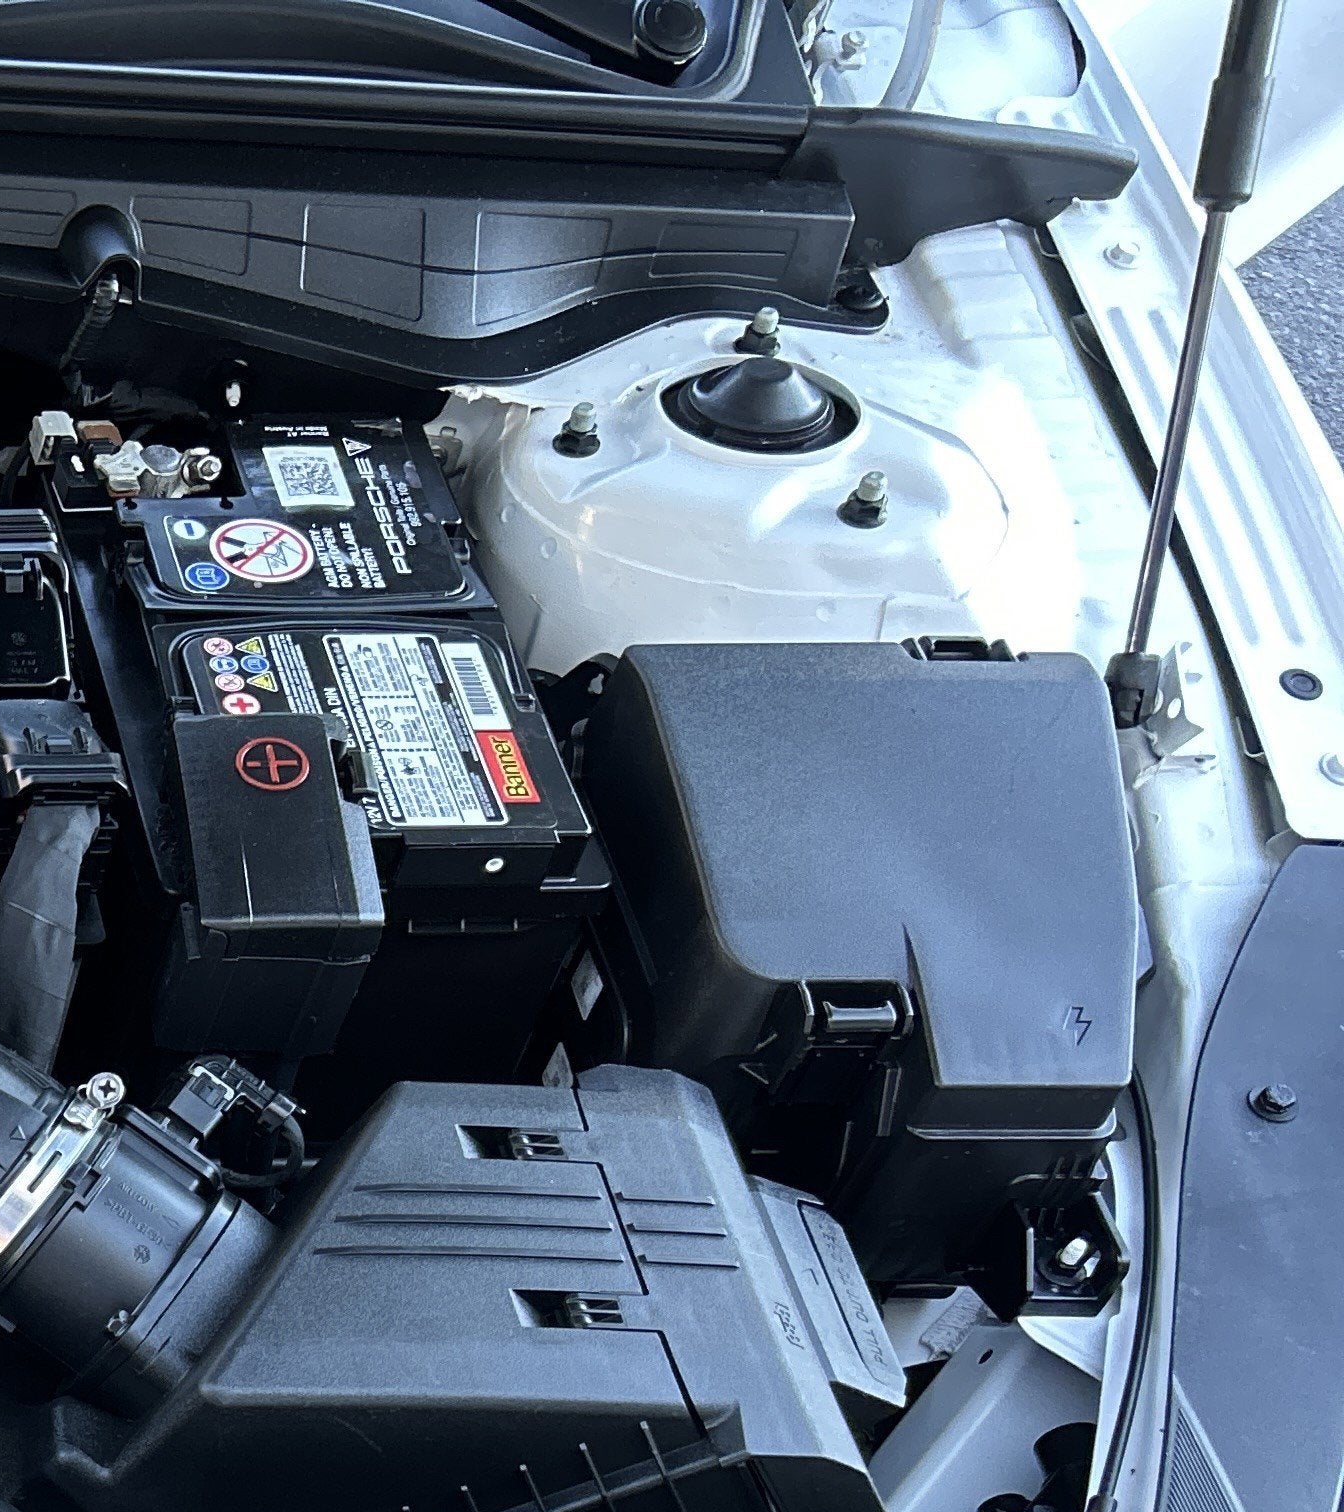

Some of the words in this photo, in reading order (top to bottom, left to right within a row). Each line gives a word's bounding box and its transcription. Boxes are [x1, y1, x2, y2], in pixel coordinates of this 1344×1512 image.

[377, 464, 390, 480] Parts
[383, 480, 401, 505] Genuine
[354, 456, 413, 574] PORSCHE
[310, 530, 331, 567] BATTERY
[322, 526, 340, 555] OPEN!
[339, 521, 365, 567] SPILLABLE
[323, 567, 340, 588] AGM
[333, 555, 347, 573] NOT
[355, 567, 372, 588] NON
[360, 547, 387, 588] BATTERY!
[339, 574, 354, 588] DO
[324, 687, 341, 706] DIN
[489, 735, 530, 797] Banner
[365, 806, 383, 825] 12V
[845, 1287, 869, 1323] OUT
[867, 1328, 889, 1368] PULL
